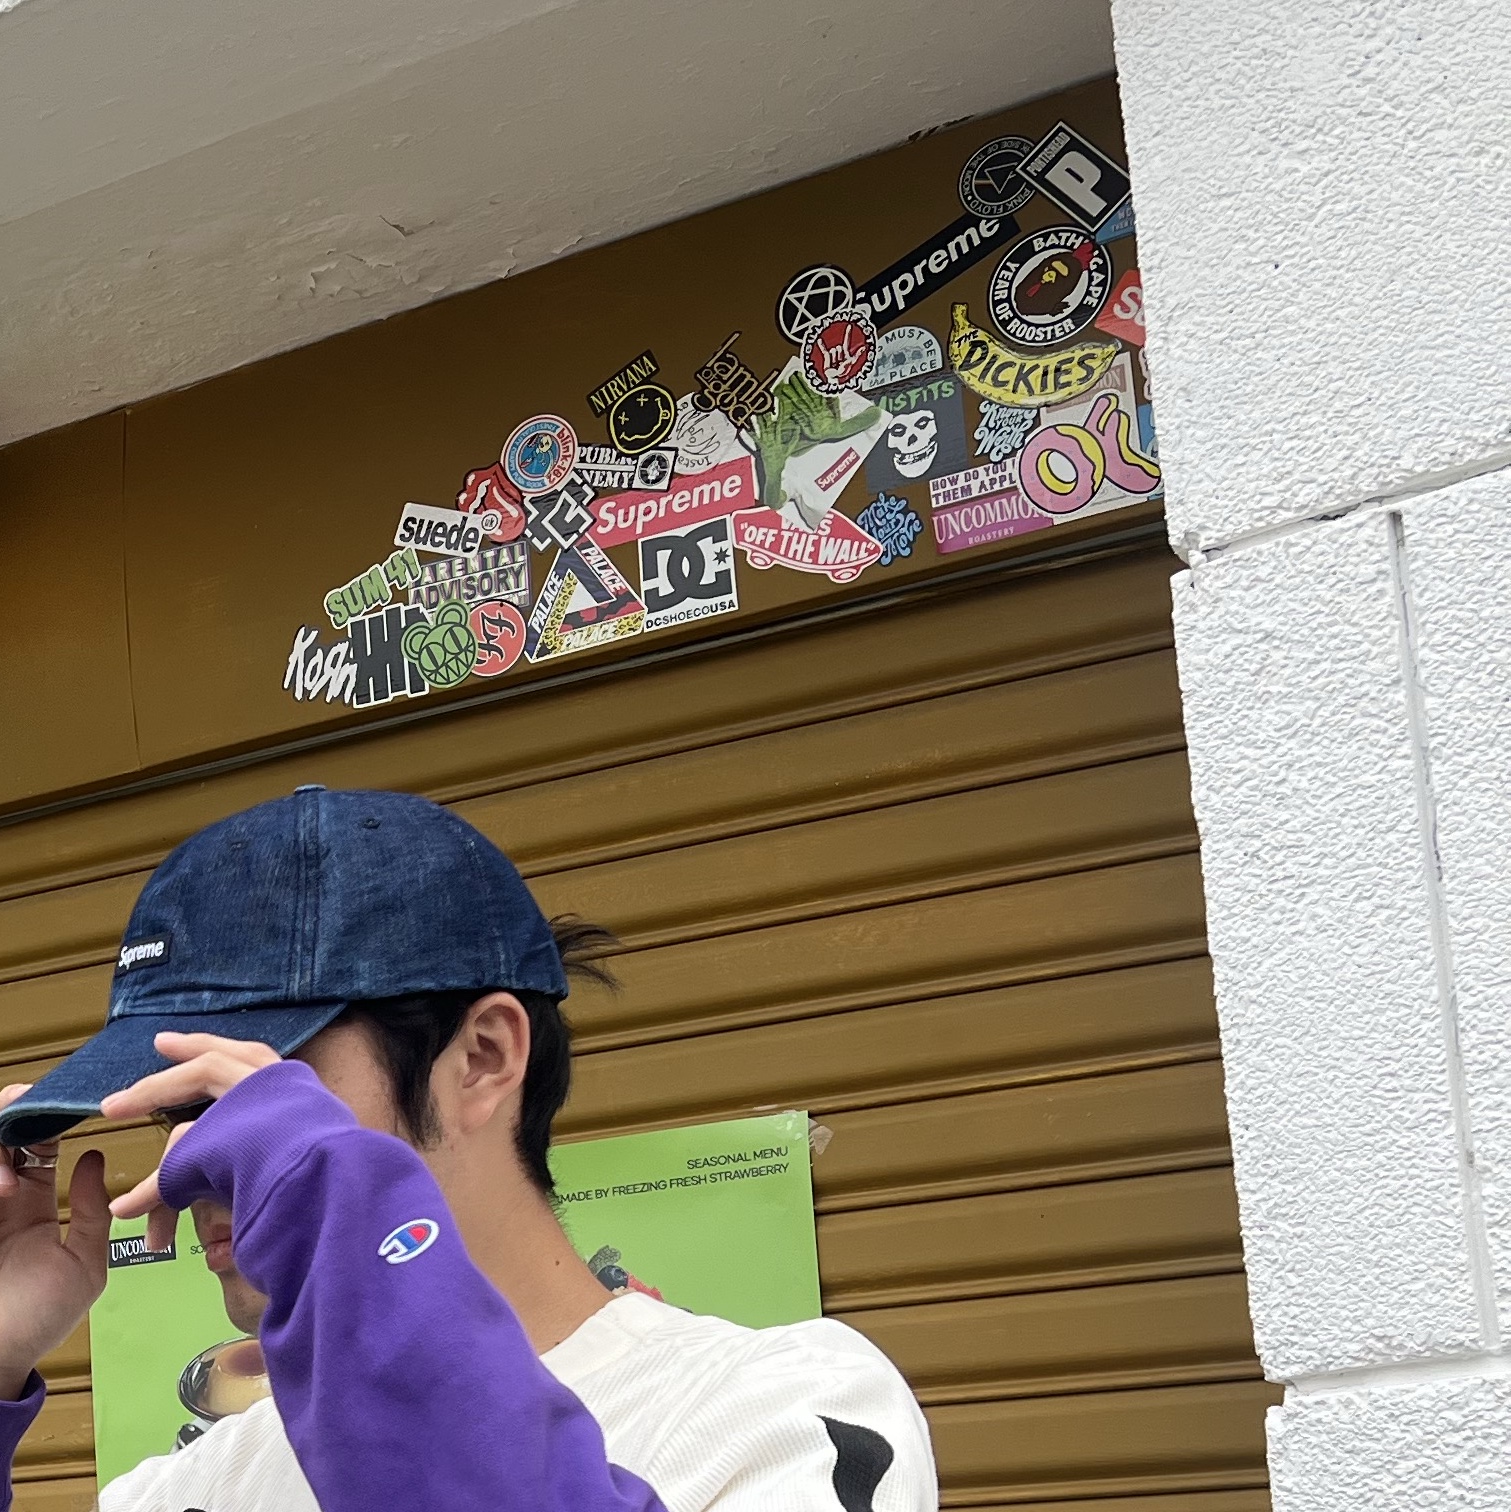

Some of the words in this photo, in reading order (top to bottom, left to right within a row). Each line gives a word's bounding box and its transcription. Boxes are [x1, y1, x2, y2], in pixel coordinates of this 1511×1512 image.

[1006, 187, 1031, 210] PINK
[1044, 150, 1108, 218] P
[969, 199, 1004, 215] FLOYD
[994, 261, 1021, 300] YEAR
[1084, 271, 1106, 308] APE
[995, 302, 1014, 321] OF
[884, 328, 924, 344] MUST
[954, 330, 979, 348] THE
[1006, 318, 1076, 341] ROOSTER
[923, 339, 937, 357] BE
[590, 355, 658, 413] NIRVANA
[889, 359, 938, 381] PLACE
[958, 340, 1098, 397] DICKIES
[546, 427, 571, 484] blink-182
[817, 450, 858, 490] Supreme
[583, 469, 635, 488] NEMY
[932, 475, 959, 492] HOW
[964, 470, 979, 483] DO
[983, 461, 1007, 477] YOU
[932, 486, 973, 506] THEM
[978, 472, 1017, 493] APPL
[597, 474, 743, 535] Supreme
[399, 515, 479, 553] suede
[779, 530, 819, 564] THE
[968, 526, 1015, 545] ROASTERY
[581, 546, 626, 594] PALACE
[641, 517, 733, 614] DC
[327, 566, 390, 624] SUM
[383, 548, 419, 588] 41
[409, 564, 526, 609] ADVISORY
[531, 570, 563, 634] PALACE
[645, 599, 736, 629] DCSHOECOUSA
[563, 621, 618, 652] PALACE
[687, 1152, 752, 1170] SEASONAL
[753, 1146, 789, 1161] MENU
[558, 1190, 593, 1204] MADE
[594, 1188, 610, 1199] BY
[612, 1180, 668, 1197] FREEZING
[669, 1174, 707, 1189] FRESH
[709, 1163, 789, 1184] STRAWBERRY
